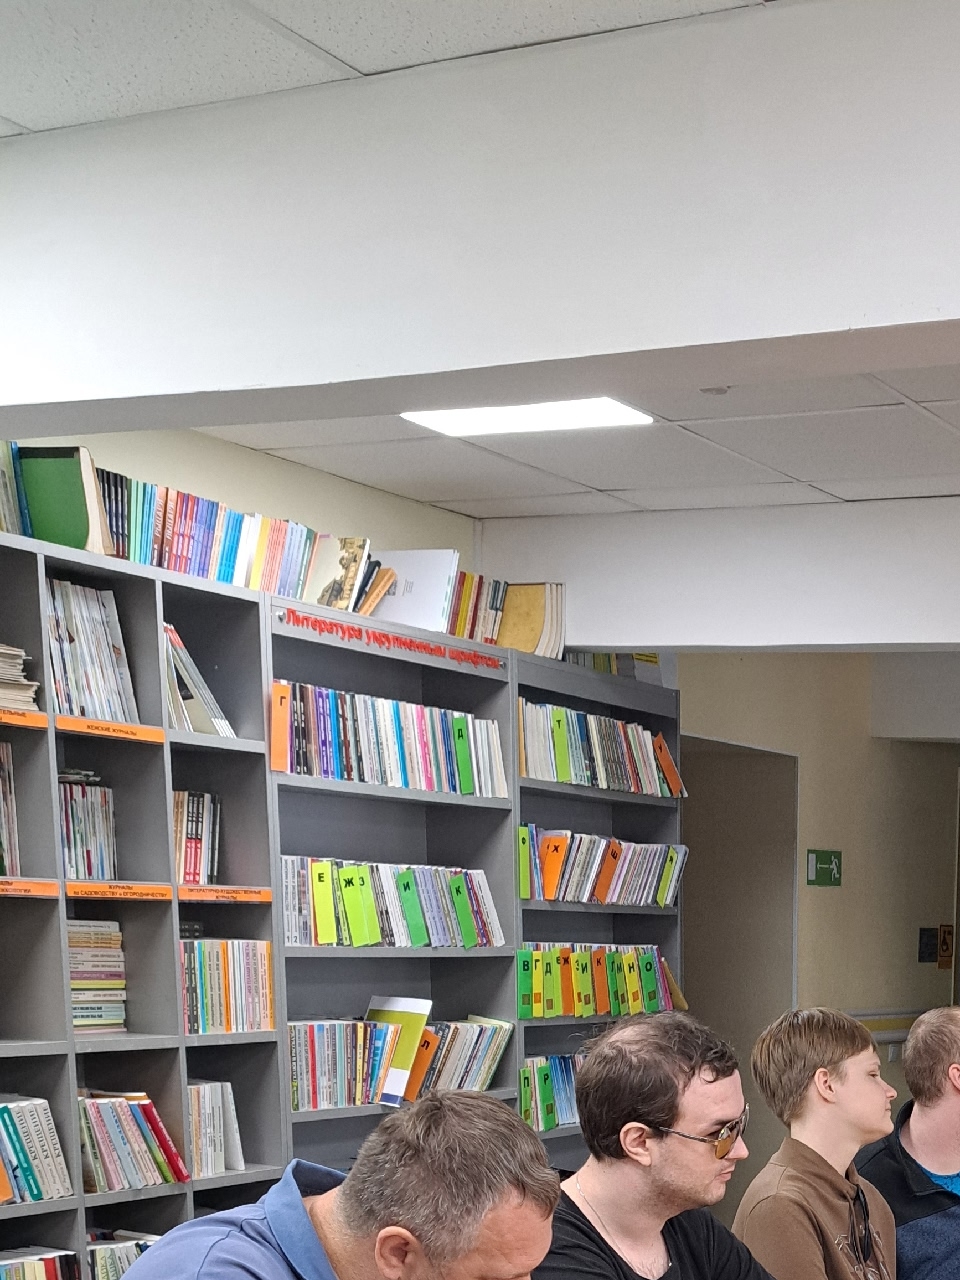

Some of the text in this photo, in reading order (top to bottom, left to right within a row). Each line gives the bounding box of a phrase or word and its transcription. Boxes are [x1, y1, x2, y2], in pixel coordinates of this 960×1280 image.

[285, 607, 363, 642] Литература
[280, 696, 286, 706] Г
[556, 719, 562, 730] Т
[457, 728, 464, 740] Д
[552, 844, 560, 854] Х
[317, 872, 325, 883] Е
[342, 876, 355, 889] Ж
[358, 876, 365, 887] З
[402, 881, 411, 893] И
[455, 885, 462, 897] К
[522, 960, 530, 972] В
[534, 958, 540, 971] Г
[562, 956, 570, 966] Ж
[596, 957, 602, 967] К
[644, 961, 653, 972] О
[544, 962, 552, 976] Д
[581, 962, 588, 975] И
[627, 962, 635, 974] Н
[420, 1039, 431, 1051] Л
[523, 1076, 530, 1089] П
[543, 1072, 550, 1086] Р
